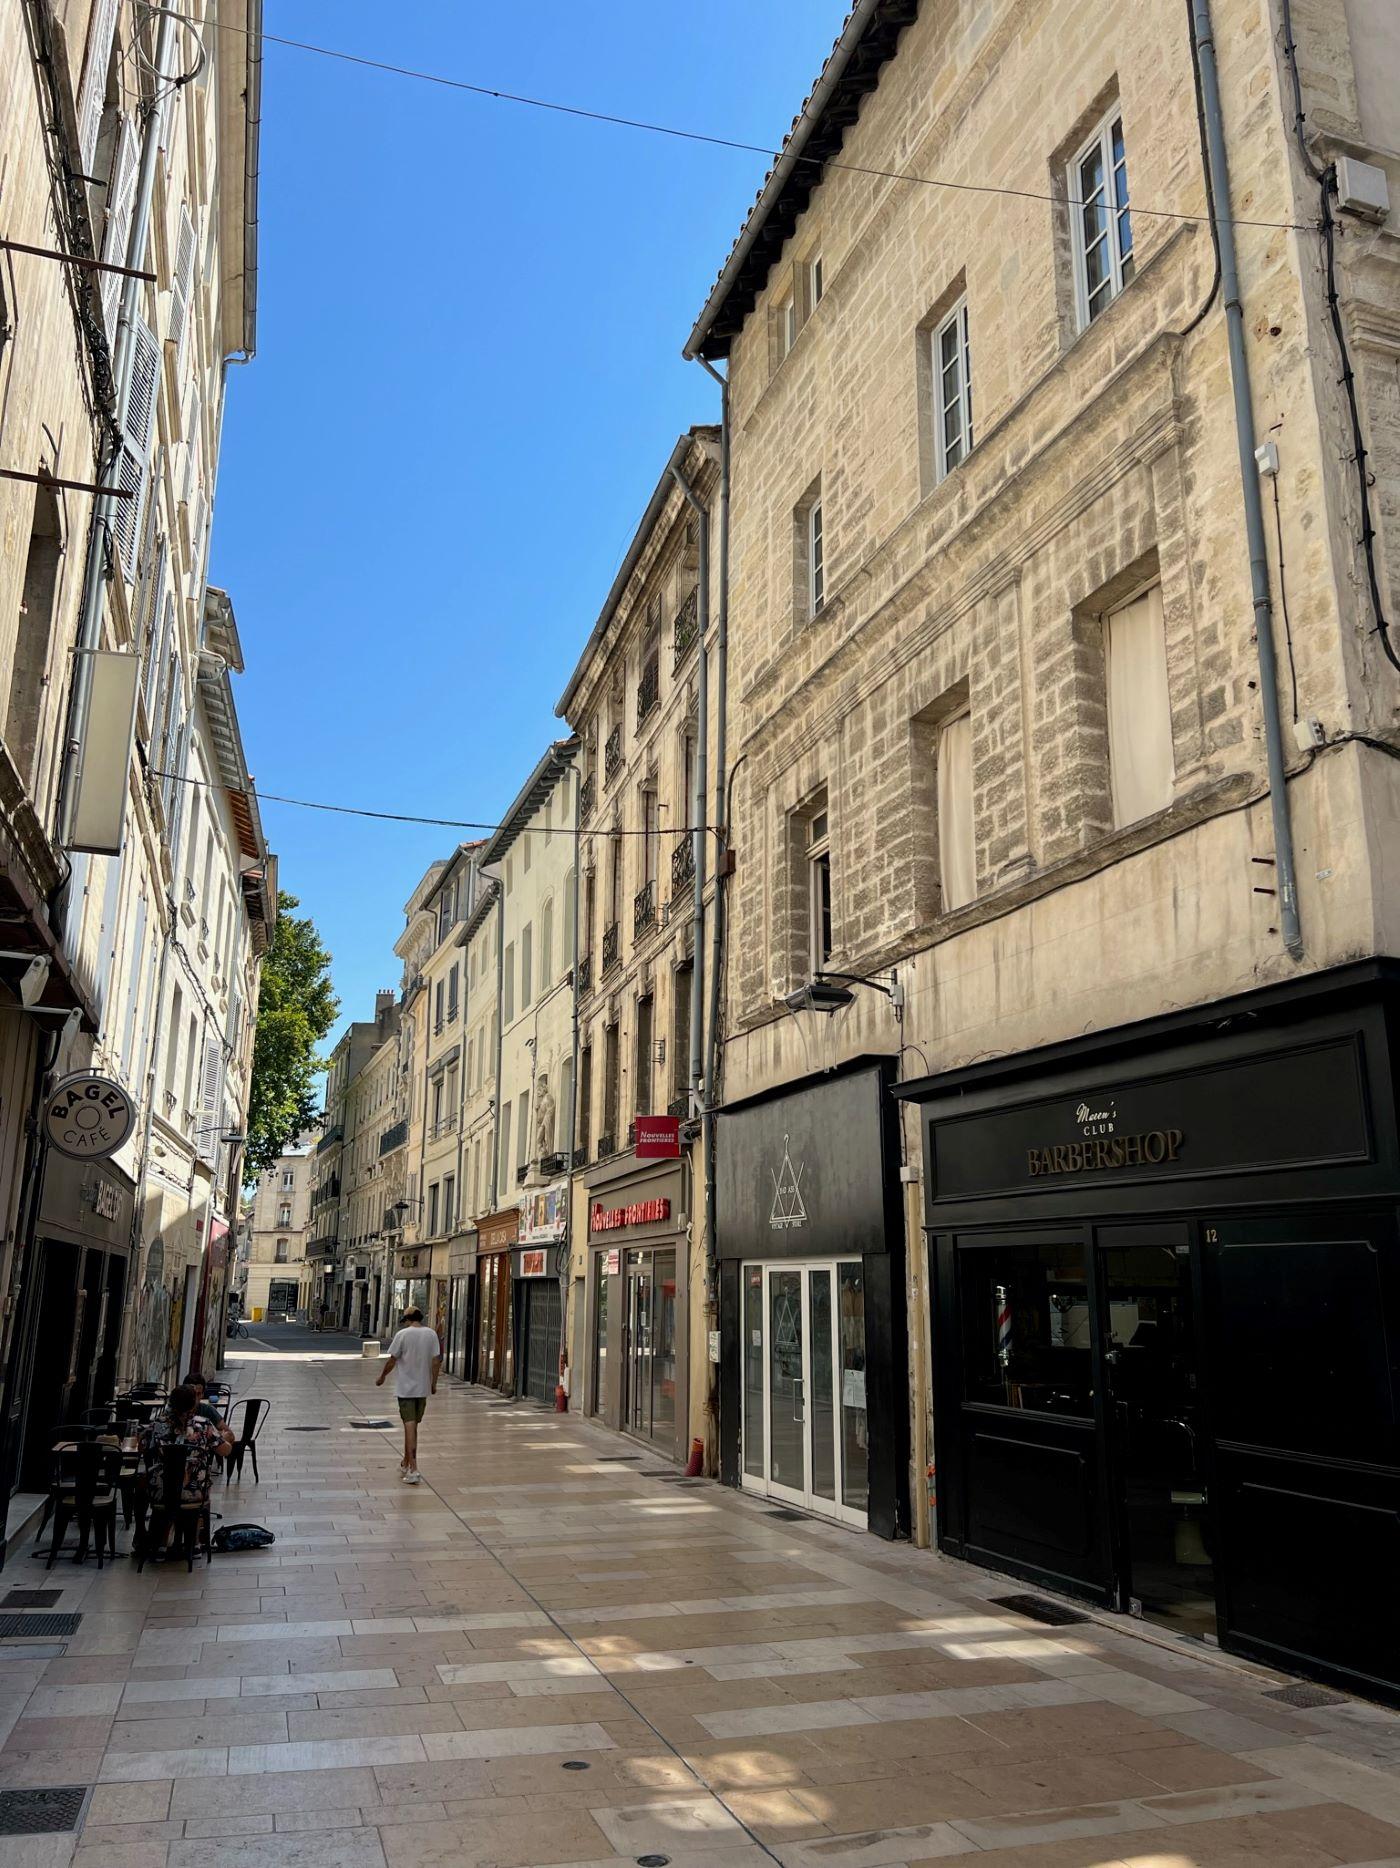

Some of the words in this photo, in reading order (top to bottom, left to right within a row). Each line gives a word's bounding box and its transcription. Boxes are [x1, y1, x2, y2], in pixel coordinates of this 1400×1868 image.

[51, 1084, 125, 1119] BAGEL
[1083, 1123, 1114, 1136] CLUB
[1027, 1129, 1183, 1176] BARBERSHOP
[592, 1203, 625, 1232] NOUVELLES
[1206, 1229, 1218, 1243] 12
